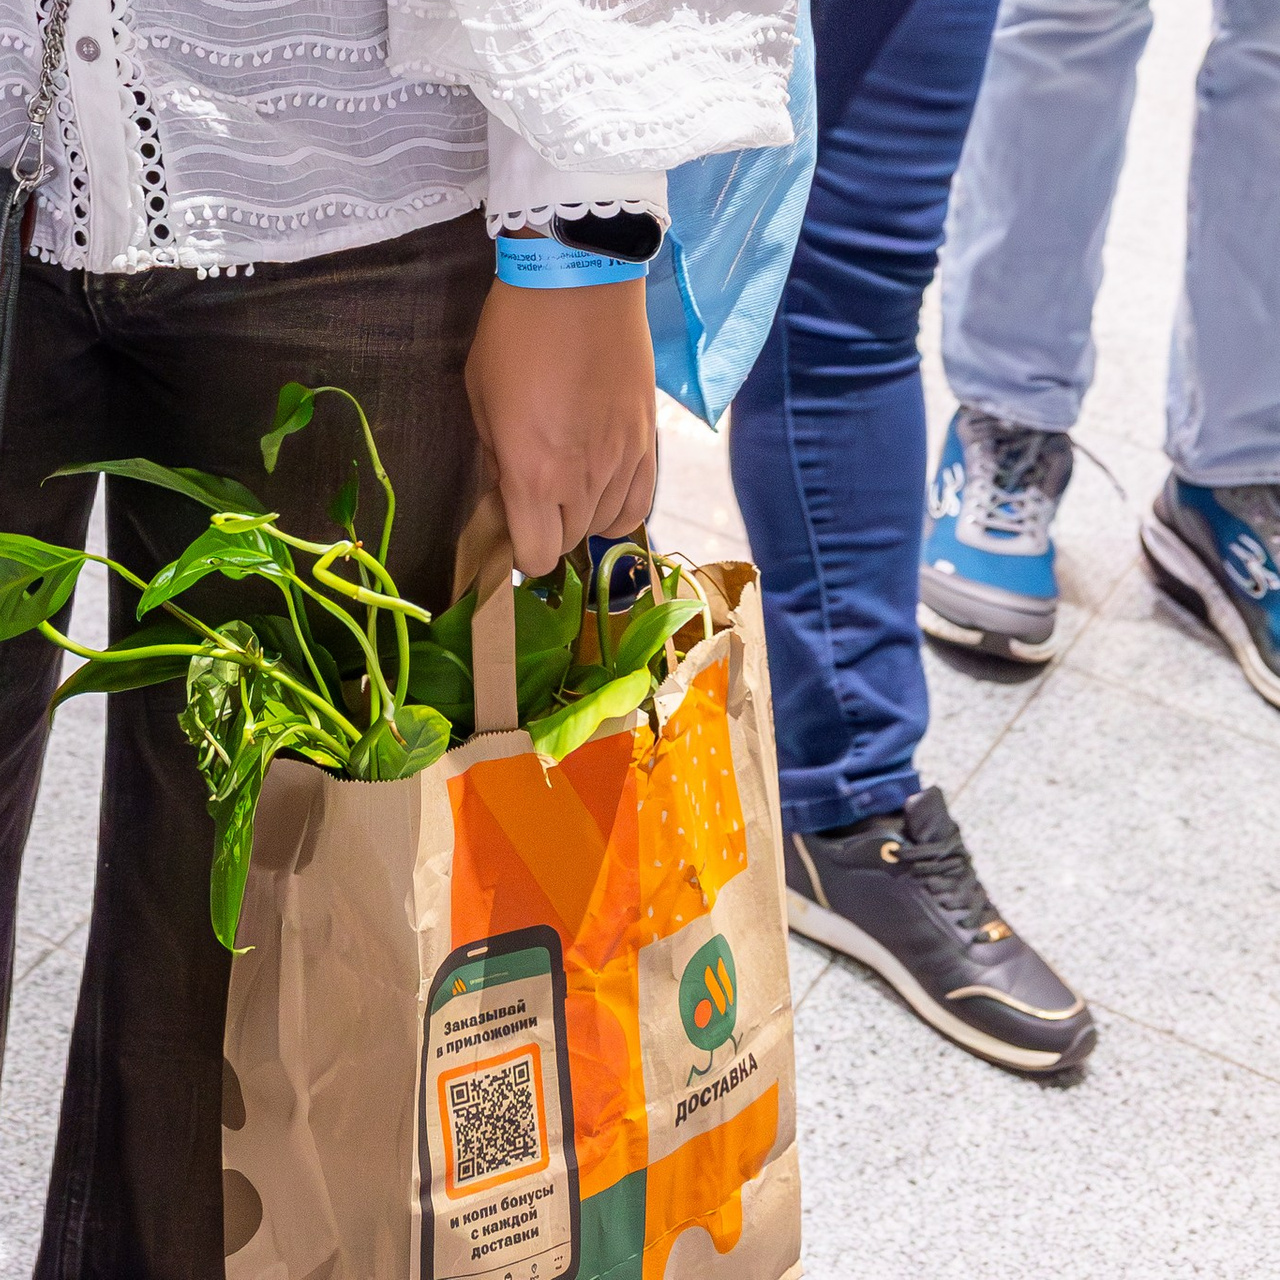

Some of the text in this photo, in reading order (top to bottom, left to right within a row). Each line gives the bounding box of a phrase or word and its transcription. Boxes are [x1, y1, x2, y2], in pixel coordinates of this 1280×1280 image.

[444, 999, 526, 1036] Заказывай
[436, 1046, 444, 1058] в
[675, 1052, 758, 1128] ДОСТАВКА
[450, 1183, 554, 1229] и копи бонусы
[471, 1205, 538, 1240] с каждой
[471, 1226, 539, 1261] доставки
